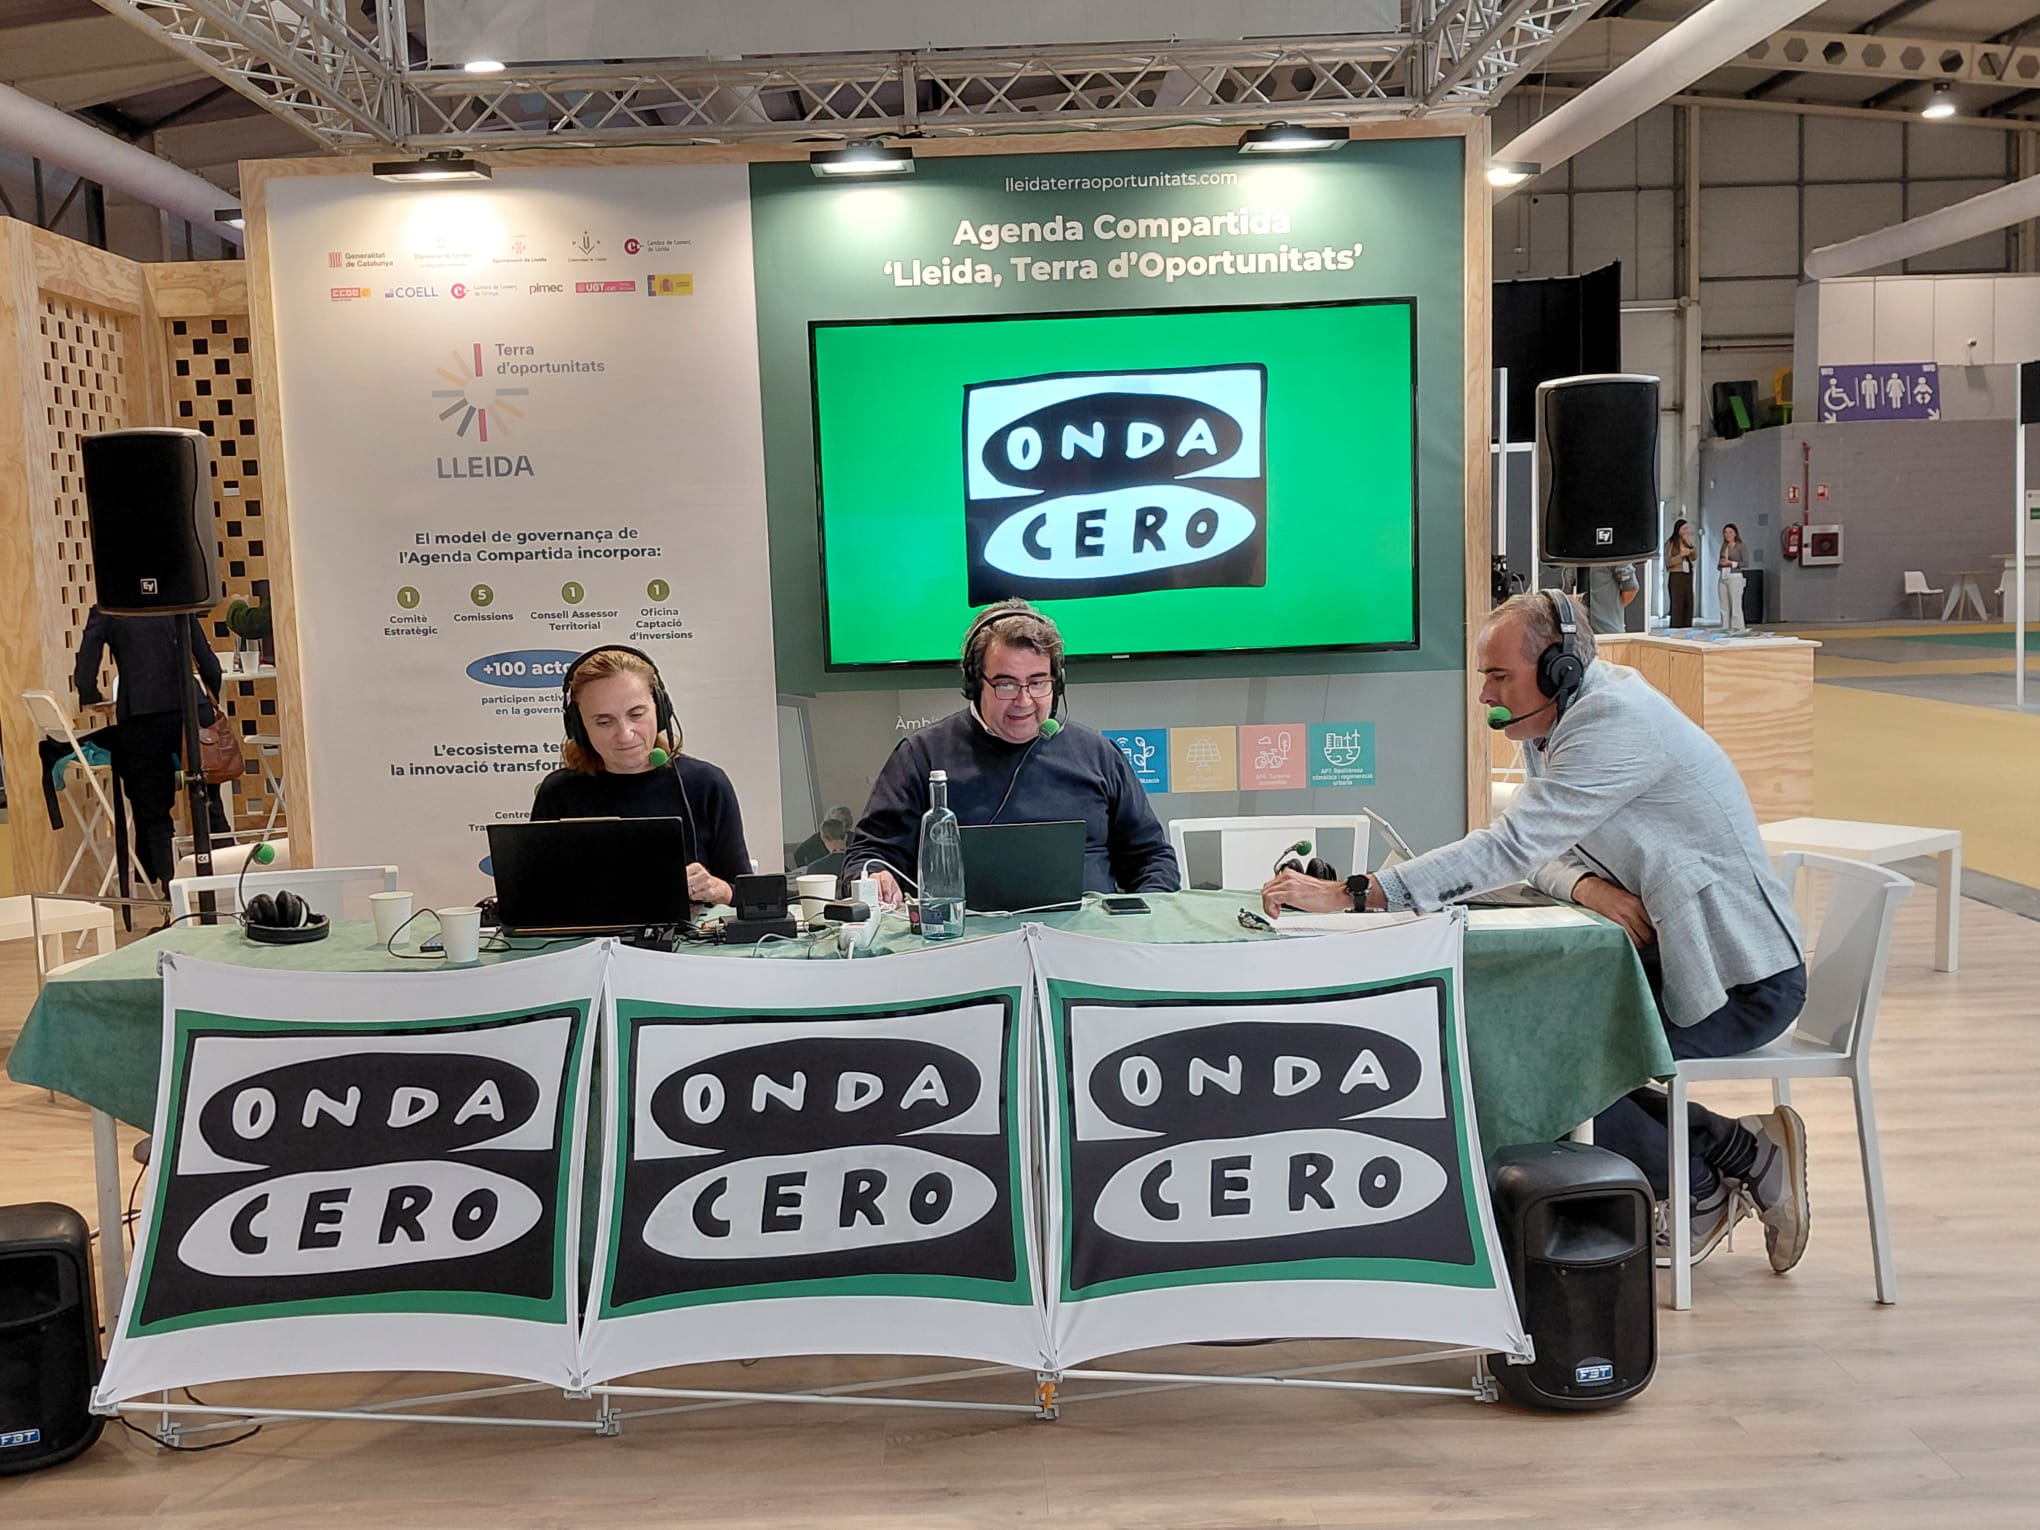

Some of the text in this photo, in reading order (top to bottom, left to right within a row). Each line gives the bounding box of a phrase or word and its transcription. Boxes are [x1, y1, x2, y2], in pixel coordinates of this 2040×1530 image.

[1005, 170, 1238, 193] lleidaterraoportunitats.com
[952, 207, 1292, 251] Agenda Compartida
[345, 252, 386, 260] Generalitat
[356, 259, 394, 268] Catalunya
[1010, 255, 1098, 284] Terra
[395, 286, 439, 298] COELL
[529, 282, 564, 295] pimec
[495, 343, 534, 356] Terra
[1006, 418, 1217, 470] ONDA
[437, 455, 535, 479] LLEIDA
[415, 527, 638, 545] El model de governança de
[1022, 506, 1219, 561] CERO
[477, 546, 573, 563] Compartida
[577, 546, 662, 561] incorpora:
[453, 612, 514, 622] Comissions
[530, 609, 618, 620] Consell Assessor
[640, 607, 679, 617] Oficina
[384, 626, 438, 637] Estratègic
[549, 621, 601, 631] Territorial
[636, 618, 682, 630] Captació
[483, 661, 526, 676] +100
[481, 695, 536, 706] participen
[495, 707, 509, 716] en
[511, 706, 521, 715] la
[391, 764, 405, 776] la
[409, 760, 489, 776] innovació
[1119, 1049, 1391, 1107] ONDA
[681, 1064, 950, 1124] ONDA
[231, 1079, 505, 1140] ONDA
[1140, 1152, 1402, 1221] CERO
[692, 1168, 953, 1239] CERO
[230, 1185, 499, 1256] CERO
